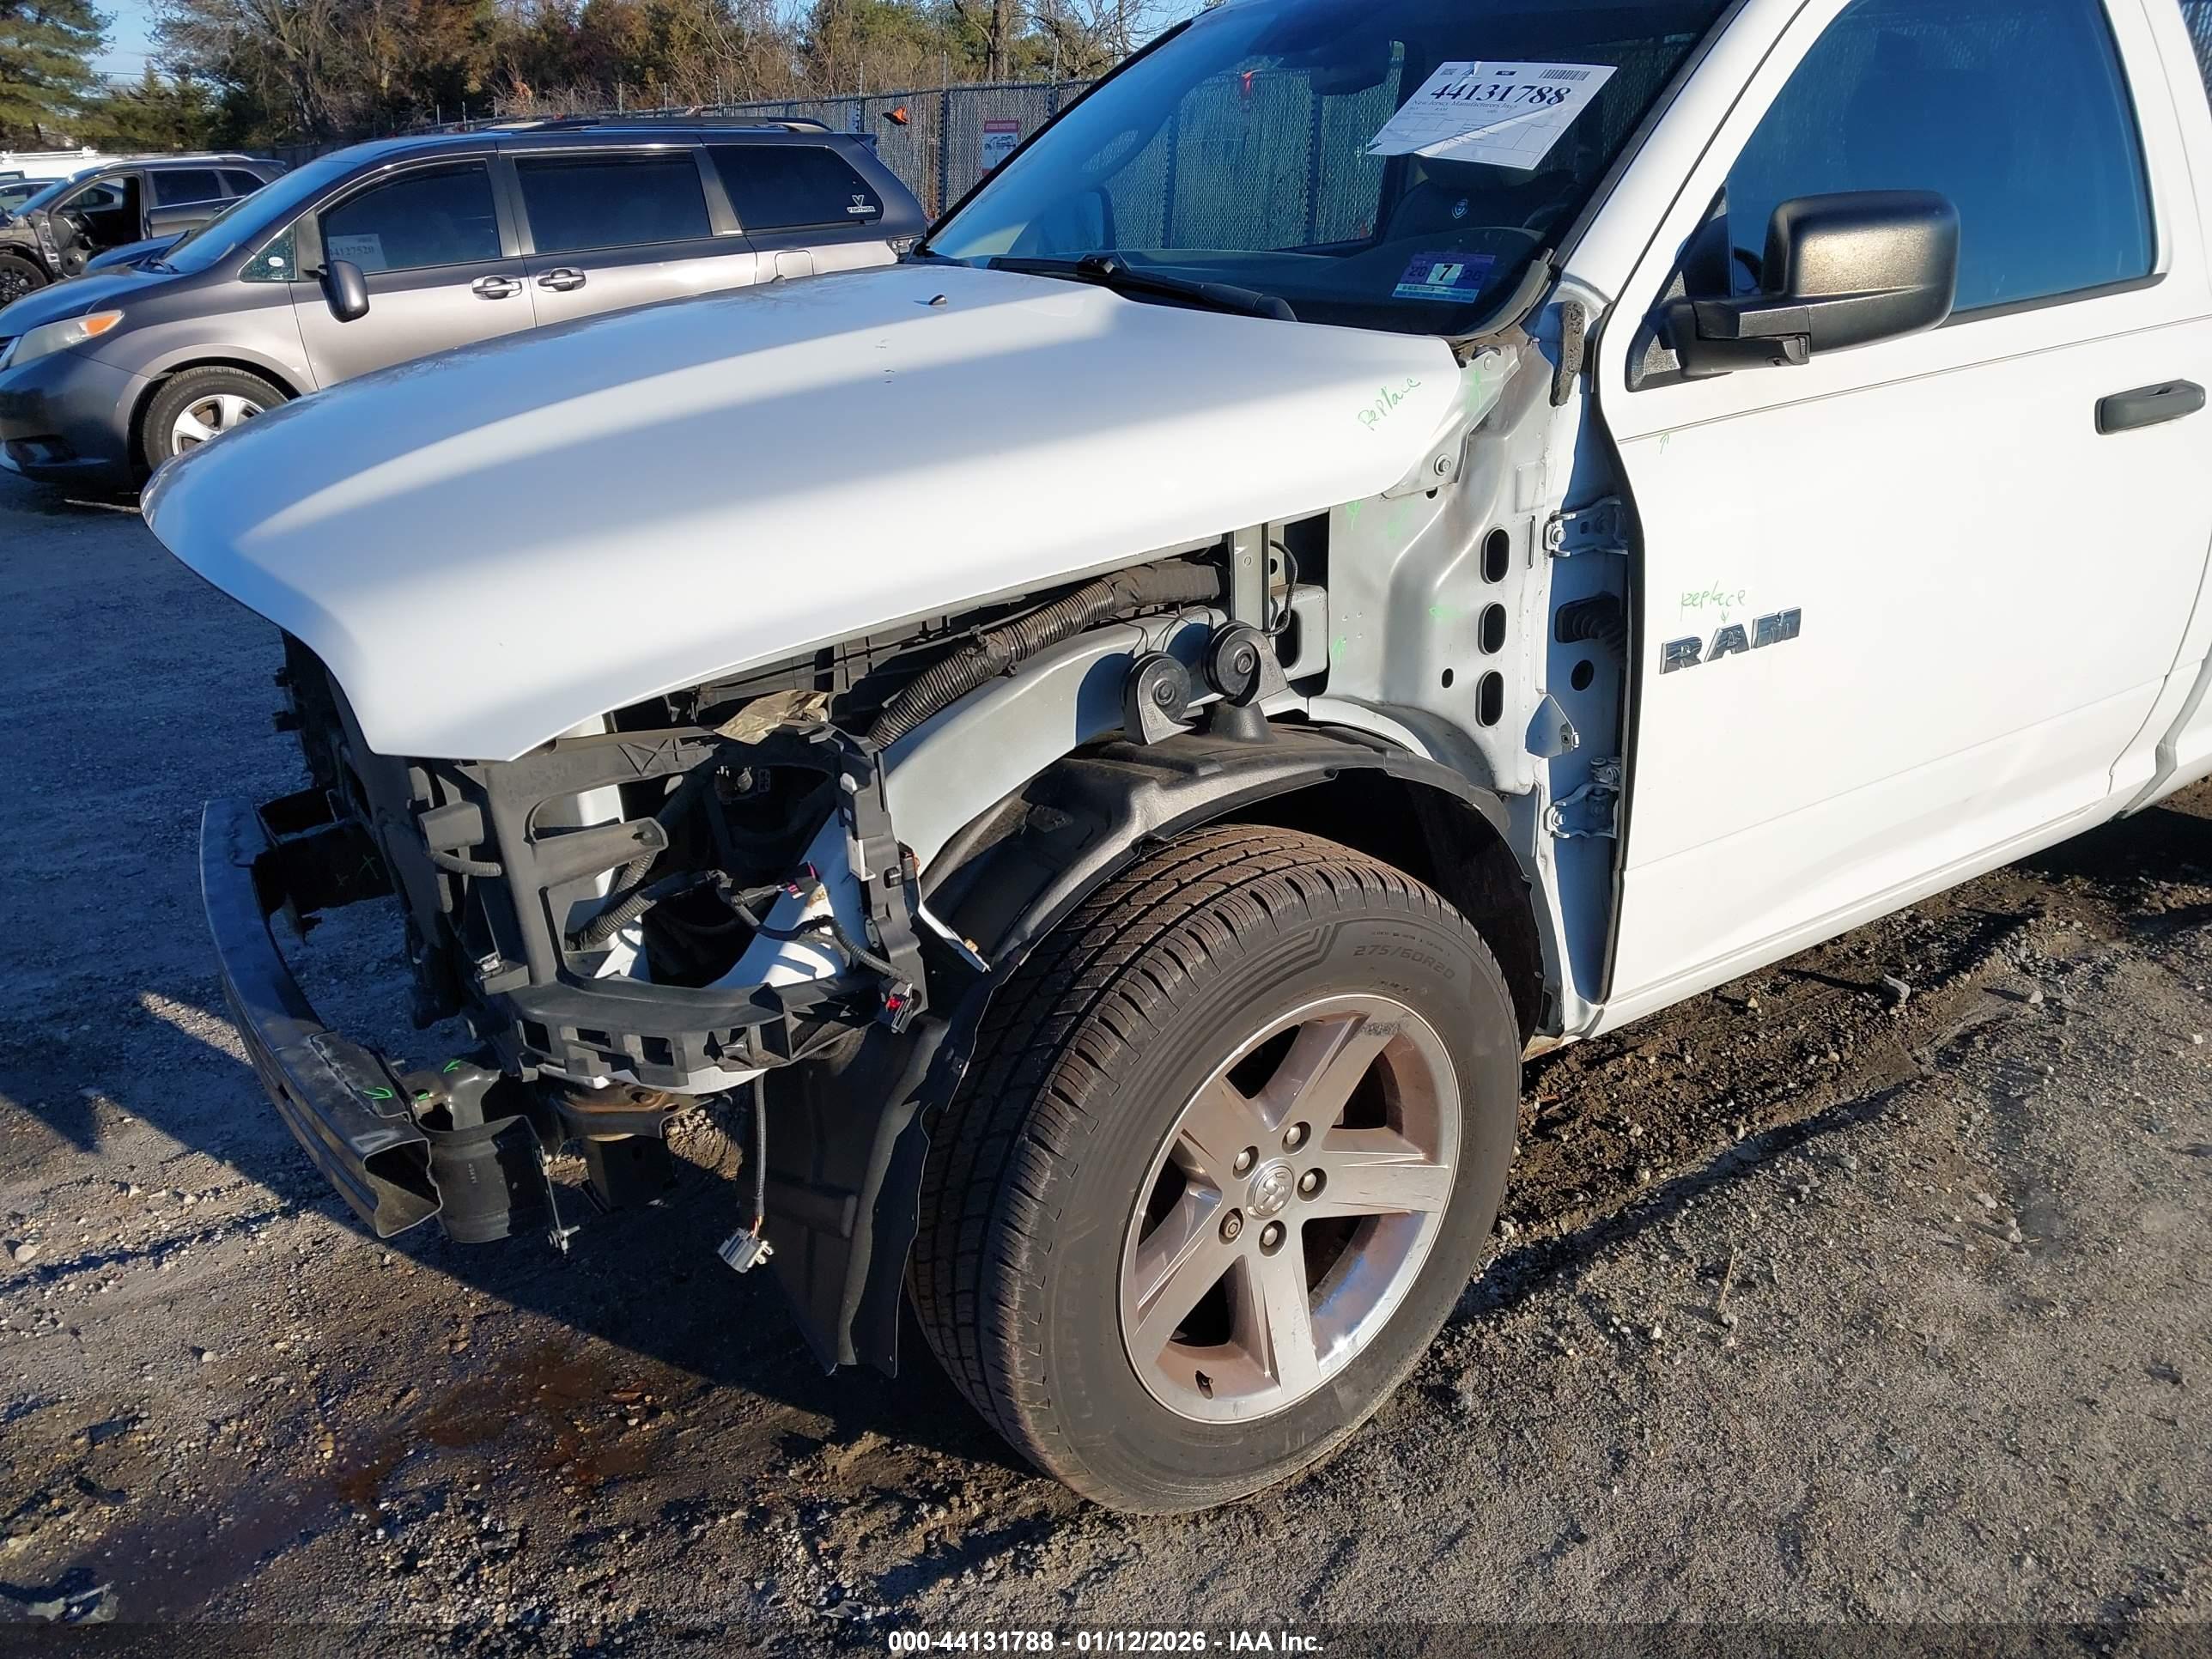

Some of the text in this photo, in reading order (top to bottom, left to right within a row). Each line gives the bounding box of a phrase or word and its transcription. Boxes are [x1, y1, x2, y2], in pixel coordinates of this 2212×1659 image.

[1430, 82, 1571, 105] 44131788
[1450, 100, 1501, 109] Manufacturers
[1408, 265, 1426, 276] 20
[1437, 264, 1454, 282] 7
[1659, 605, 1802, 675] RAM
[1352, 945, 1455, 981] 275/60R20
